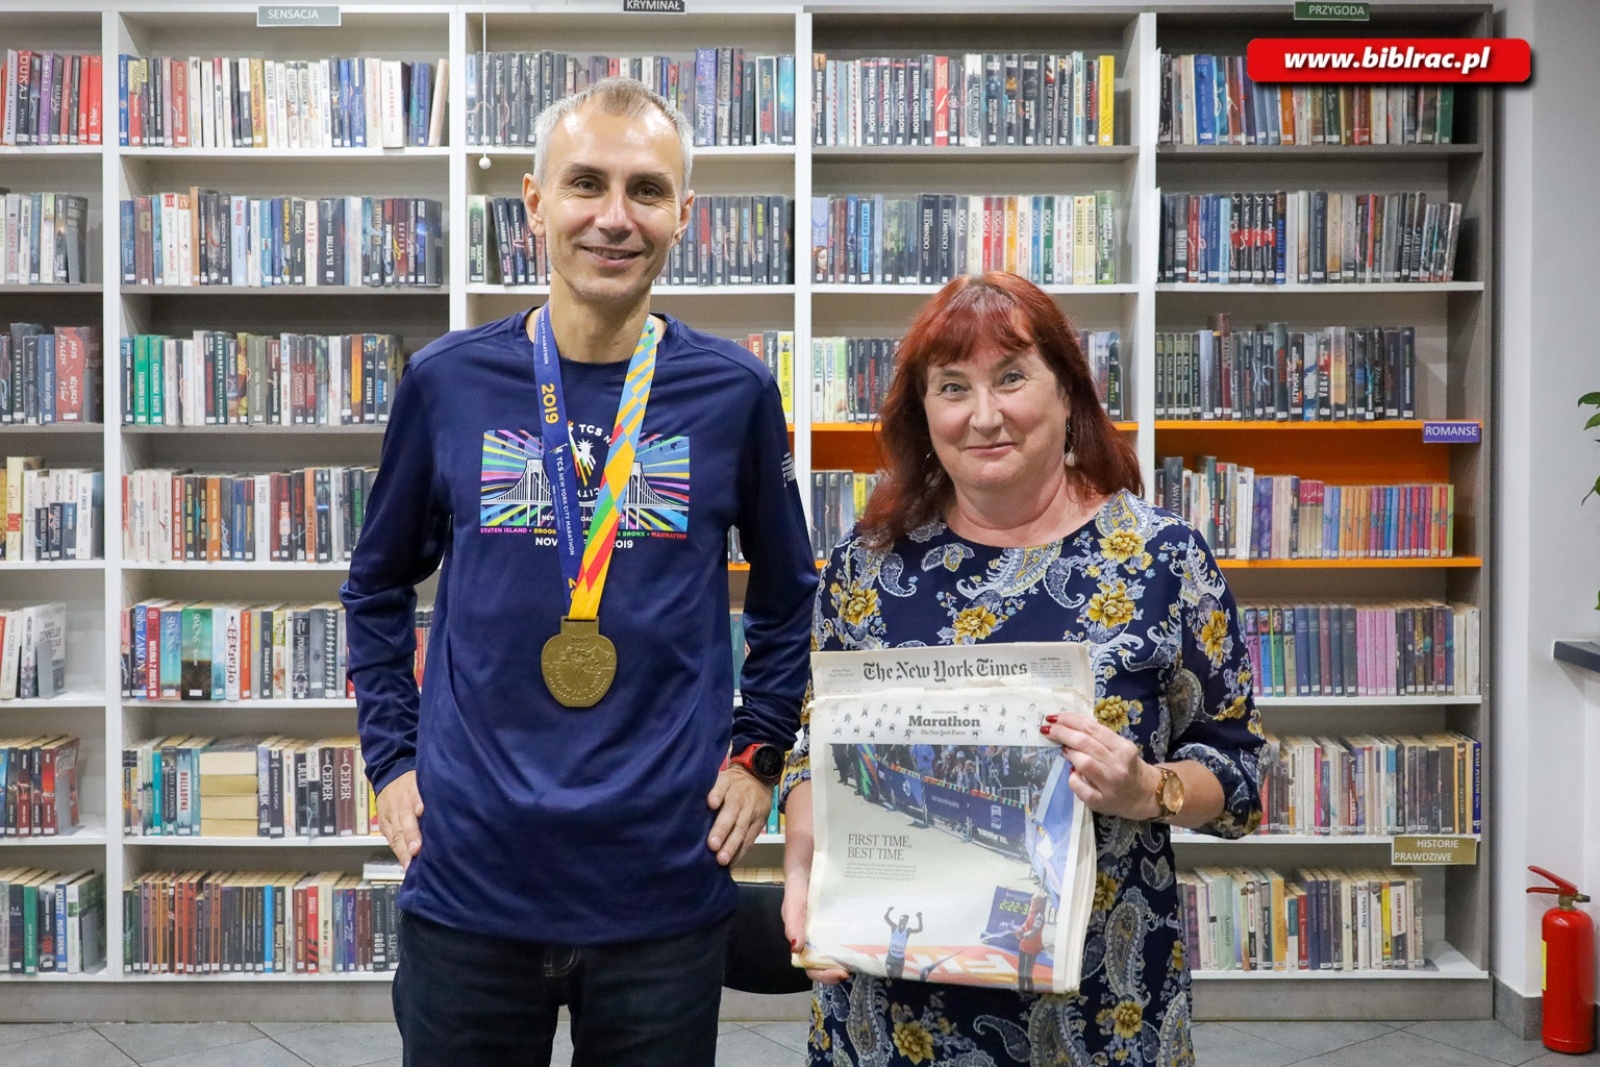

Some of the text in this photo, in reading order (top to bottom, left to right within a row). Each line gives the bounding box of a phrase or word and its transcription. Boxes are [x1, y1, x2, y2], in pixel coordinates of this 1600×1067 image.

[268, 9, 319, 20] SENSACJA
[626, 0, 680, 10] KRYMINAŁ
[1308, 6, 1365, 16] PRZYGODA
[19, 56, 29, 100] DUKAJ
[958, 209, 966, 236] ROGALA
[326, 236, 335, 255] DALLAS
[541, 383, 559, 424] 2019
[578, 424, 603, 436] TCS
[1425, 426, 1478, 436] ROMANSE
[555, 456, 563, 472] TCS
[565, 520, 575, 556] MARATHON
[136, 610, 146, 631] Silva
[166, 616, 176, 650] SIMONS
[149, 640, 157, 662] WOJNA
[148, 669, 157, 689] ROSJĄ
[863, 662, 893, 683] The
[896, 660, 930, 680] New
[933, 659, 974, 683] York
[976, 658, 1028, 678] Times
[908, 716, 980, 727] Marathon
[298, 763, 307, 787] LALKI
[322, 764, 333, 800] CEDER
[340, 764, 352, 799] CEDER
[180, 772, 188, 811] BALLADYNA
[848, 833, 912, 848] FIRST TIME,
[1417, 840, 1459, 848] HISTORIE
[847, 847, 904, 861] BEST TIME
[1394, 853, 1452, 861] PRAWDZIWE
[374, 933, 385, 953] GRÓB
